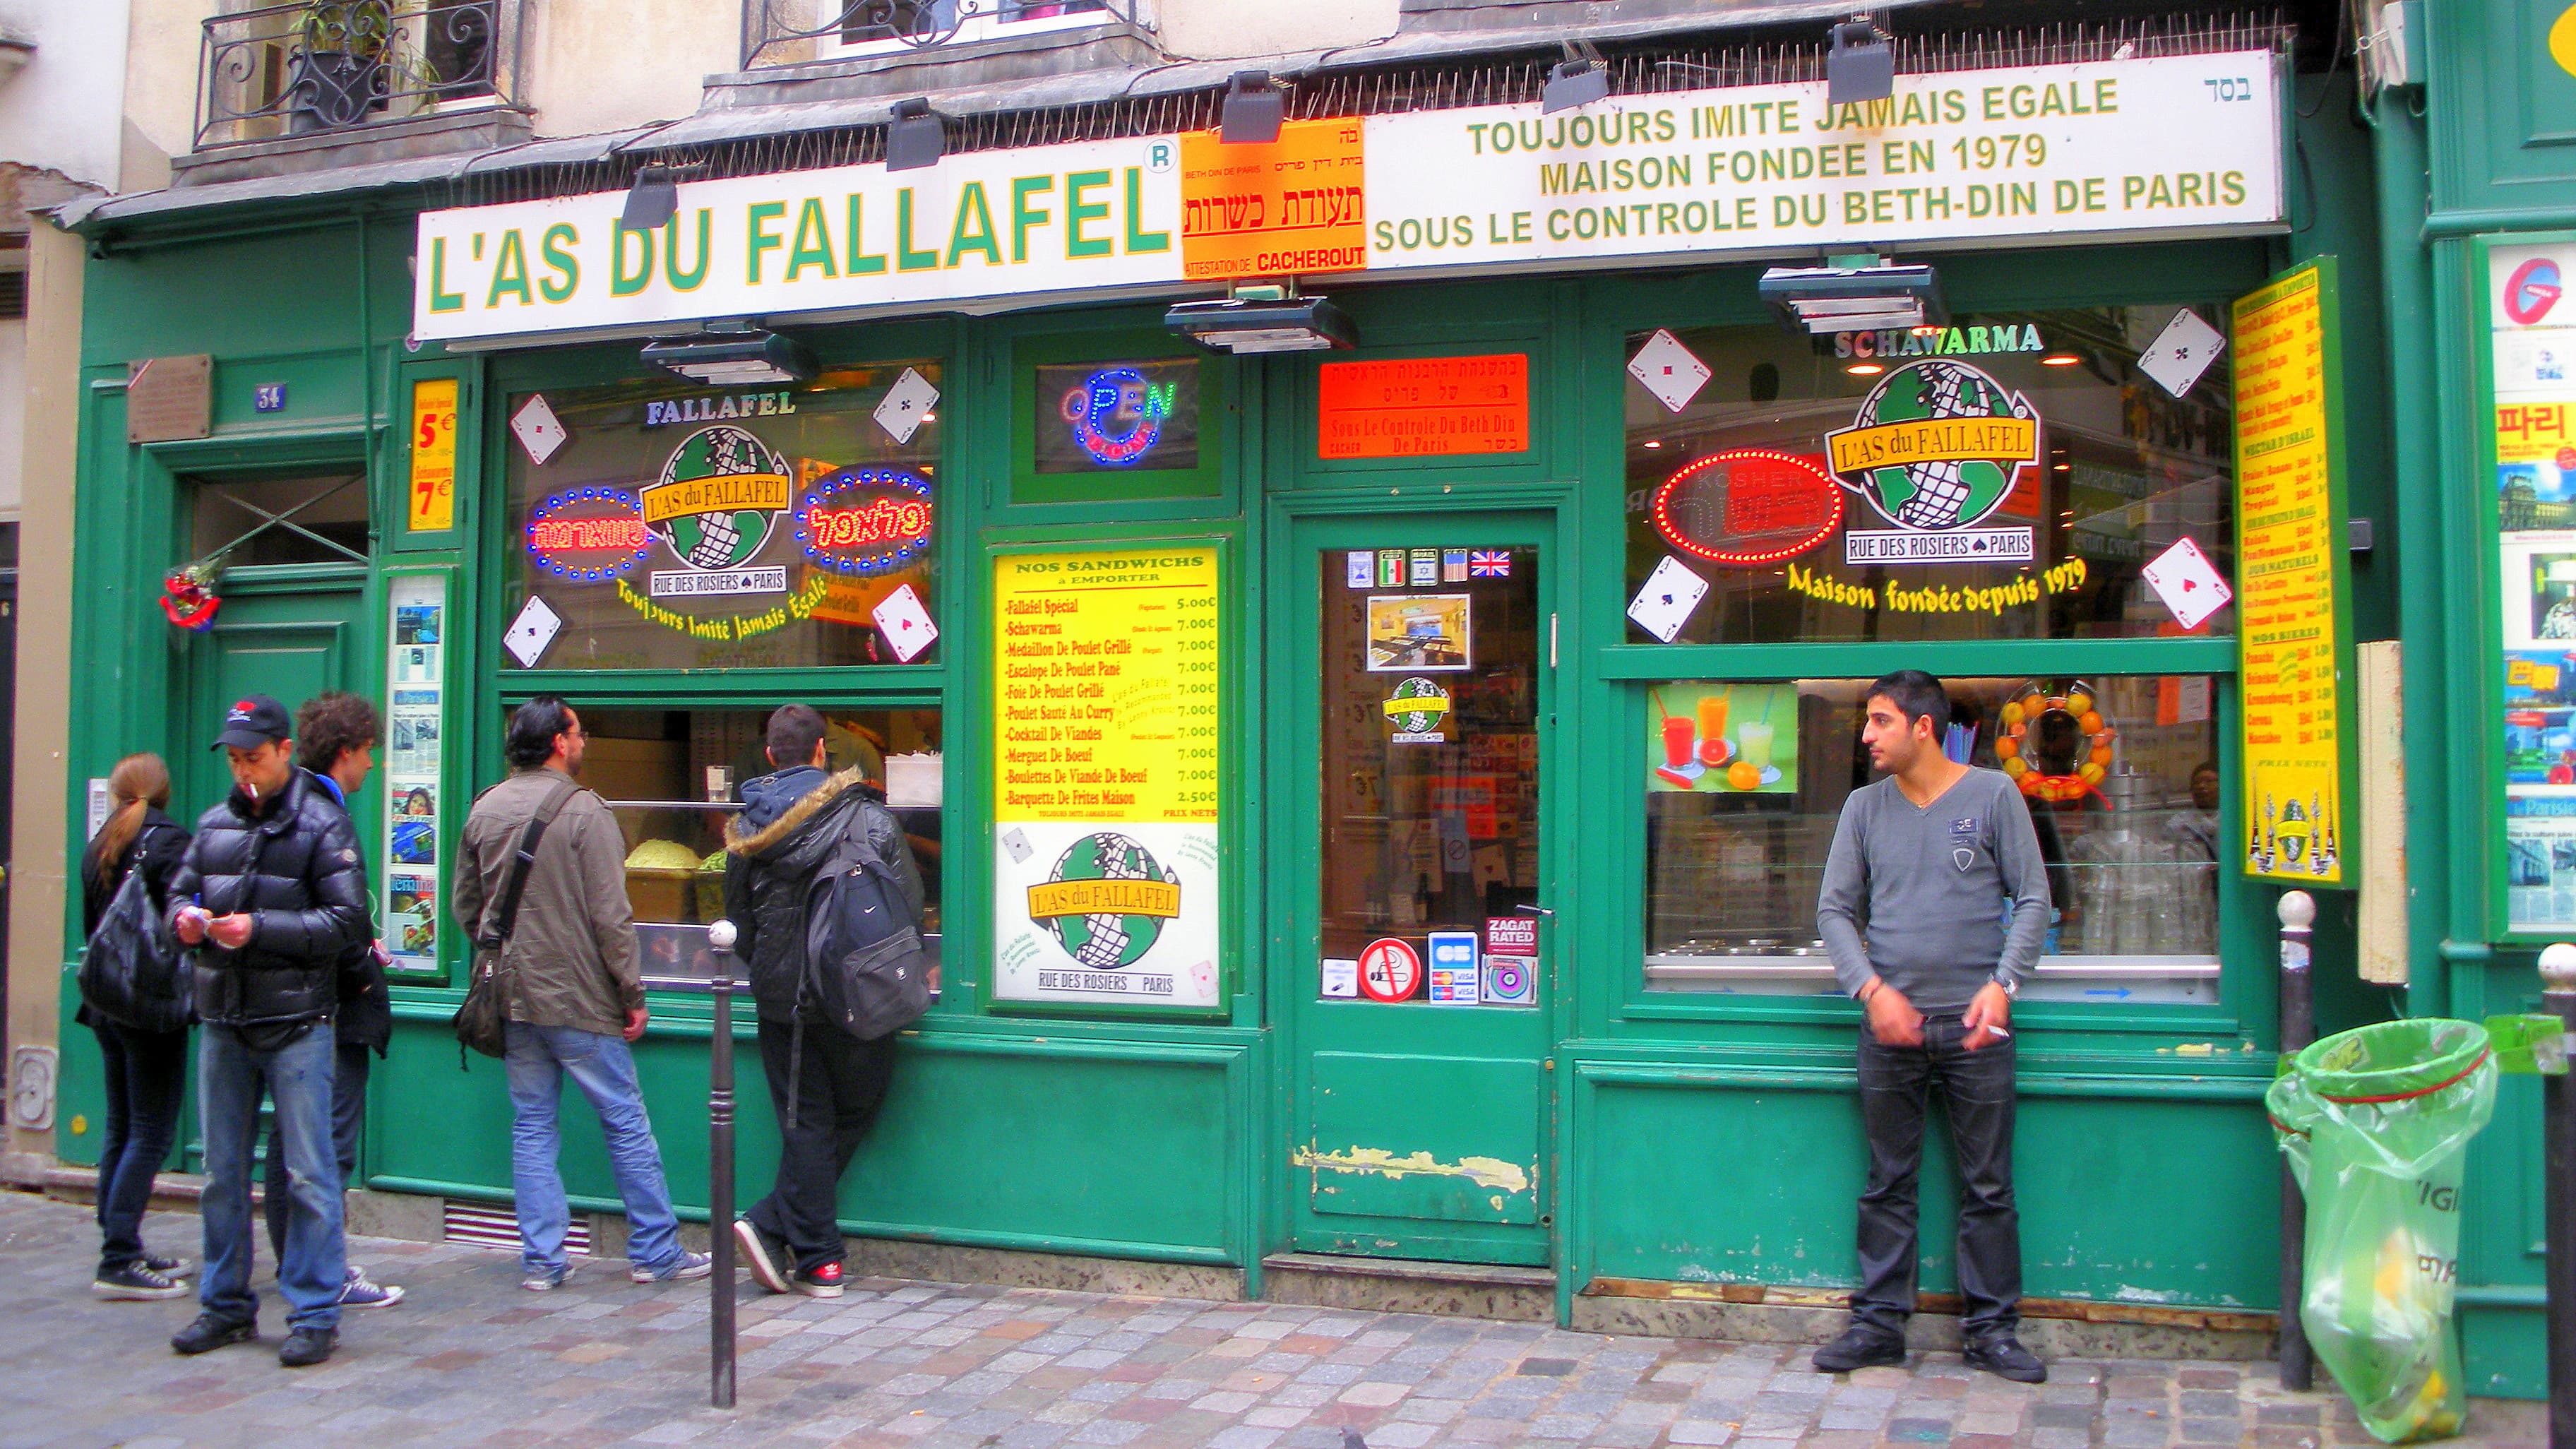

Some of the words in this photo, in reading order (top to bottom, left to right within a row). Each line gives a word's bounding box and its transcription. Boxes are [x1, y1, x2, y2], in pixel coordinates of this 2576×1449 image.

[1467, 108, 1676, 156] TOUJOURS
[1692, 100, 1801, 140] IMITE
[1815, 88, 1967, 133] JAMAIS
[1982, 78, 2119, 121] EGALE
[1186, 170, 1207, 179] BETH
[1208, 169, 1222, 177] DIN
[1224, 168, 1235, 177] DE
[1236, 165, 1261, 174] PARIS
[1540, 154, 1692, 197] MAISON
[1707, 143, 1867, 185] FONDEE
[1883, 139, 1936, 176] EN
[1951, 133, 2048, 172] 1979
[1184, 193, 1265, 232] כשרות
[1282, 186, 1362, 229] תעודת
[1373, 215, 1474, 252] SOUS
[1489, 210, 1534, 246] LE
[1546, 197, 1758, 242] CONTROLE
[1773, 193, 1827, 229] DU
[1844, 181, 2039, 226] BETH-DIN
[2053, 177, 2107, 214] DE
[2123, 170, 2247, 210] PARIS
[429, 222, 580, 315] L'AS
[610, 208, 712, 298] DU
[746, 167, 1171, 285] FALLAFEL
[1186, 259, 1236, 276] ATTESTATION
[1239, 258, 1251, 272] DE
[1257, 246, 1365, 271] CACHEROUT
[1835, 323, 2044, 359] SCHAWARMA
[258, 387, 280, 410] 34
[1061, 383, 1175, 426] OPEN
[646, 391, 797, 425] FALLAFEL
[1331, 419, 1359, 437] Sous
[1364, 418, 1377, 436] Le
[1381, 417, 1435, 435] Controle
[1440, 417, 1455, 434] Du
[1460, 415, 1489, 434] Beth
[1494, 415, 1515, 433] Din
[2497, 405, 2565, 441] 파리
[1393, 437, 1409, 453] De
[1414, 436, 1448, 453] Paris
[1841, 436, 1885, 468] L'AS
[1890, 432, 1912, 453] du
[1917, 425, 2028, 455] FALLAFEL
[649, 496, 681, 519] L'AS
[684, 485, 700, 505] du
[704, 481, 783, 506] FALLAFEL
[1849, 539, 1875, 557] RUE
[1879, 538, 1905, 556] DES
[1910, 537, 1968, 556] ROSIERS
[1990, 535, 2030, 554] PARIS
[1016, 561, 1060, 573] NOS
[1067, 556, 1204, 571] SANDWICHS
[653, 577, 672, 593] RUE
[675, 576, 693, 592] DES
[697, 575, 739, 591] ROSIERS
[753, 573, 783, 590] PARIS
[1071, 573, 1159, 584] EMPORTER
[1787, 562, 1876, 609] Maison
[1885, 580, 1961, 612] fondée
[1964, 575, 2040, 616] depuis
[2043, 557, 2088, 595] 1979
[1044, 598, 1078, 617] Spécial
[1176, 597, 1216, 609] 5.00€
[734, 608, 786, 640] Jamais
[1177, 619, 1216, 631] 7.00€
[1056, 641, 1068, 656] De
[1071, 640, 1102, 656] Poulet
[1104, 639, 1132, 655] Grillé
[1177, 640, 1216, 653] 7.00€
[1051, 662, 1063, 677] De
[1066, 662, 1096, 677] Poulet
[1098, 660, 1121, 676] Pané
[1178, 662, 1216, 674] 7.00€
[1030, 684, 1042, 698] De
[1044, 684, 1074, 698] Poulet
[1077, 683, 1104, 698] Grillé
[1177, 684, 1216, 696] 7.00€
[1040, 705, 1066, 720] Sauté
[1069, 705, 1083, 720] Au
[1086, 704, 1115, 722] Curry
[1177, 705, 1216, 717] 7.00€
[1050, 727, 1062, 741] De
[1065, 725, 1102, 741] Viandes
[1177, 727, 1216, 739] 7.00€
[1050, 748, 1063, 763] De
[1065, 746, 1092, 763] Boeuf
[1177, 749, 1216, 761] 7.00€
[1054, 769, 1066, 784] De
[1069, 768, 1102, 784] Viande
[1104, 768, 1117, 783] De
[1119, 768, 1148, 783] Boeuf
[1177, 770, 1216, 782] 7.00€
[1058, 790, 1070, 805] De
[1072, 789, 1099, 805] Frites
[1102, 789, 1135, 805] Maison
[1178, 792, 1216, 803] 2.50€
[1163, 809, 1187, 818] PRIX
[1034, 893, 1068, 914] L'AS
[1073, 886, 1090, 905] du
[1092, 885, 1175, 911] FALLAFEL
[1489, 919, 1535, 931] ZAGAT
[1489, 931, 1534, 943] RATED
[1039, 972, 1059, 988] RUE
[1061, 973, 1080, 988] DES
[1084, 974, 1128, 990] ROSIERS
[1143, 977, 1174, 992] PARIS
[1457, 972, 1475, 981] VISA
